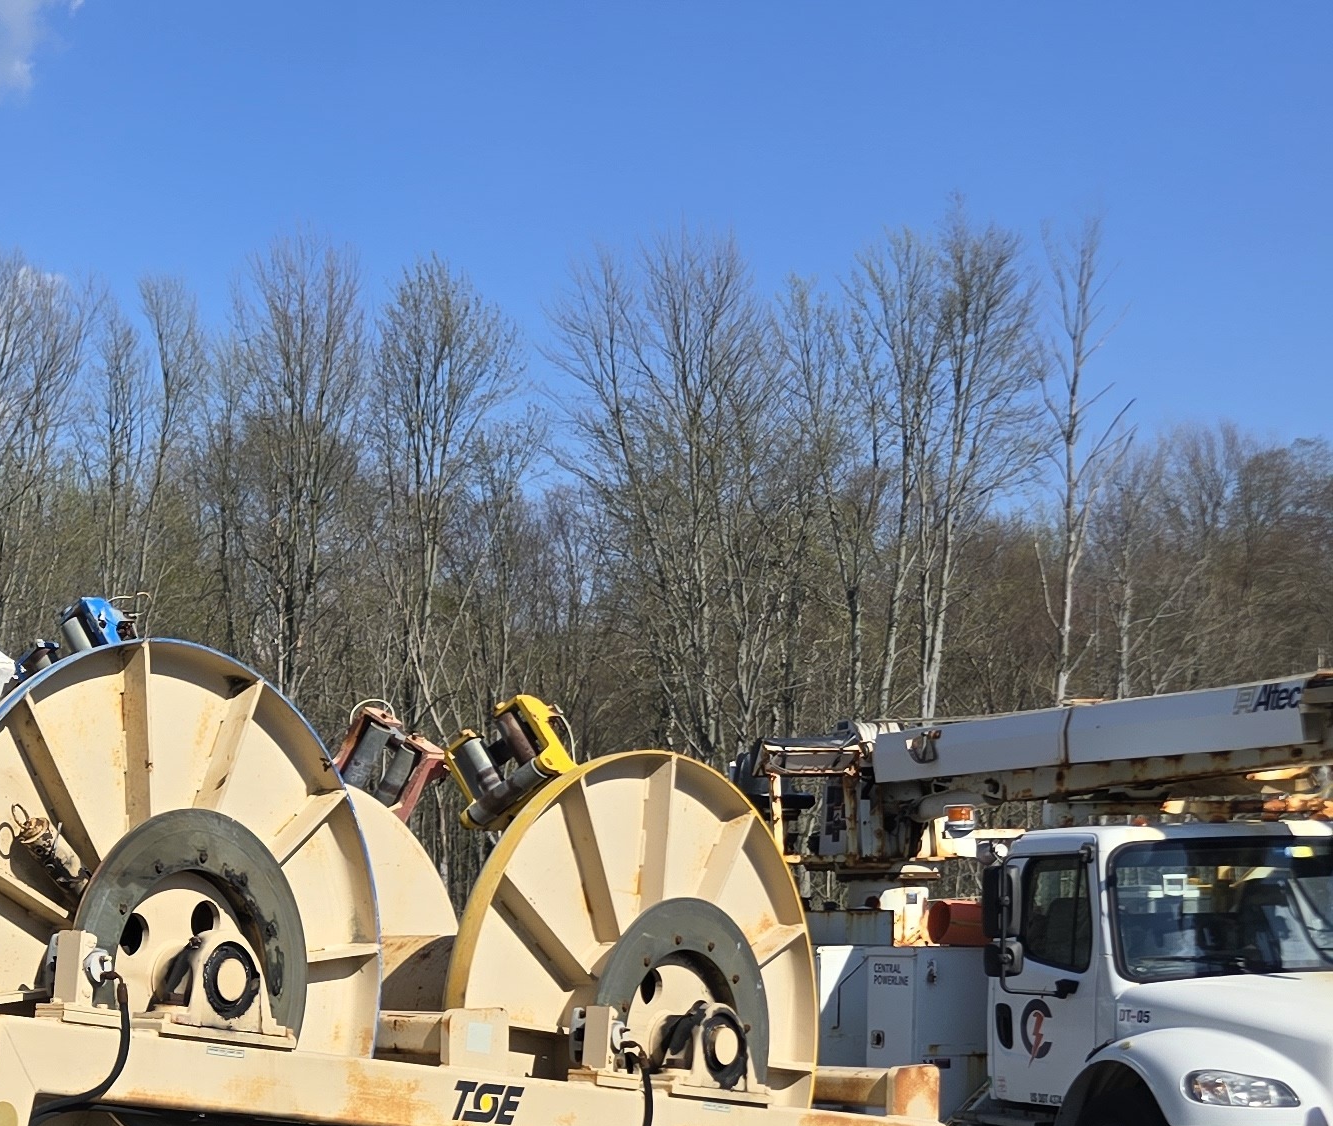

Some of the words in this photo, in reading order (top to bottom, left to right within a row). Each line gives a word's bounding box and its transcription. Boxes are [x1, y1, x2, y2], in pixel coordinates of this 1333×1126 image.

[1252, 684, 1301, 712] Altec
[873, 962, 902, 974] CENTRAL
[873, 974, 909, 986] POWERLINE
[1119, 1008, 1151, 1024] DT-05
[452, 1080, 525, 1125] TSE
